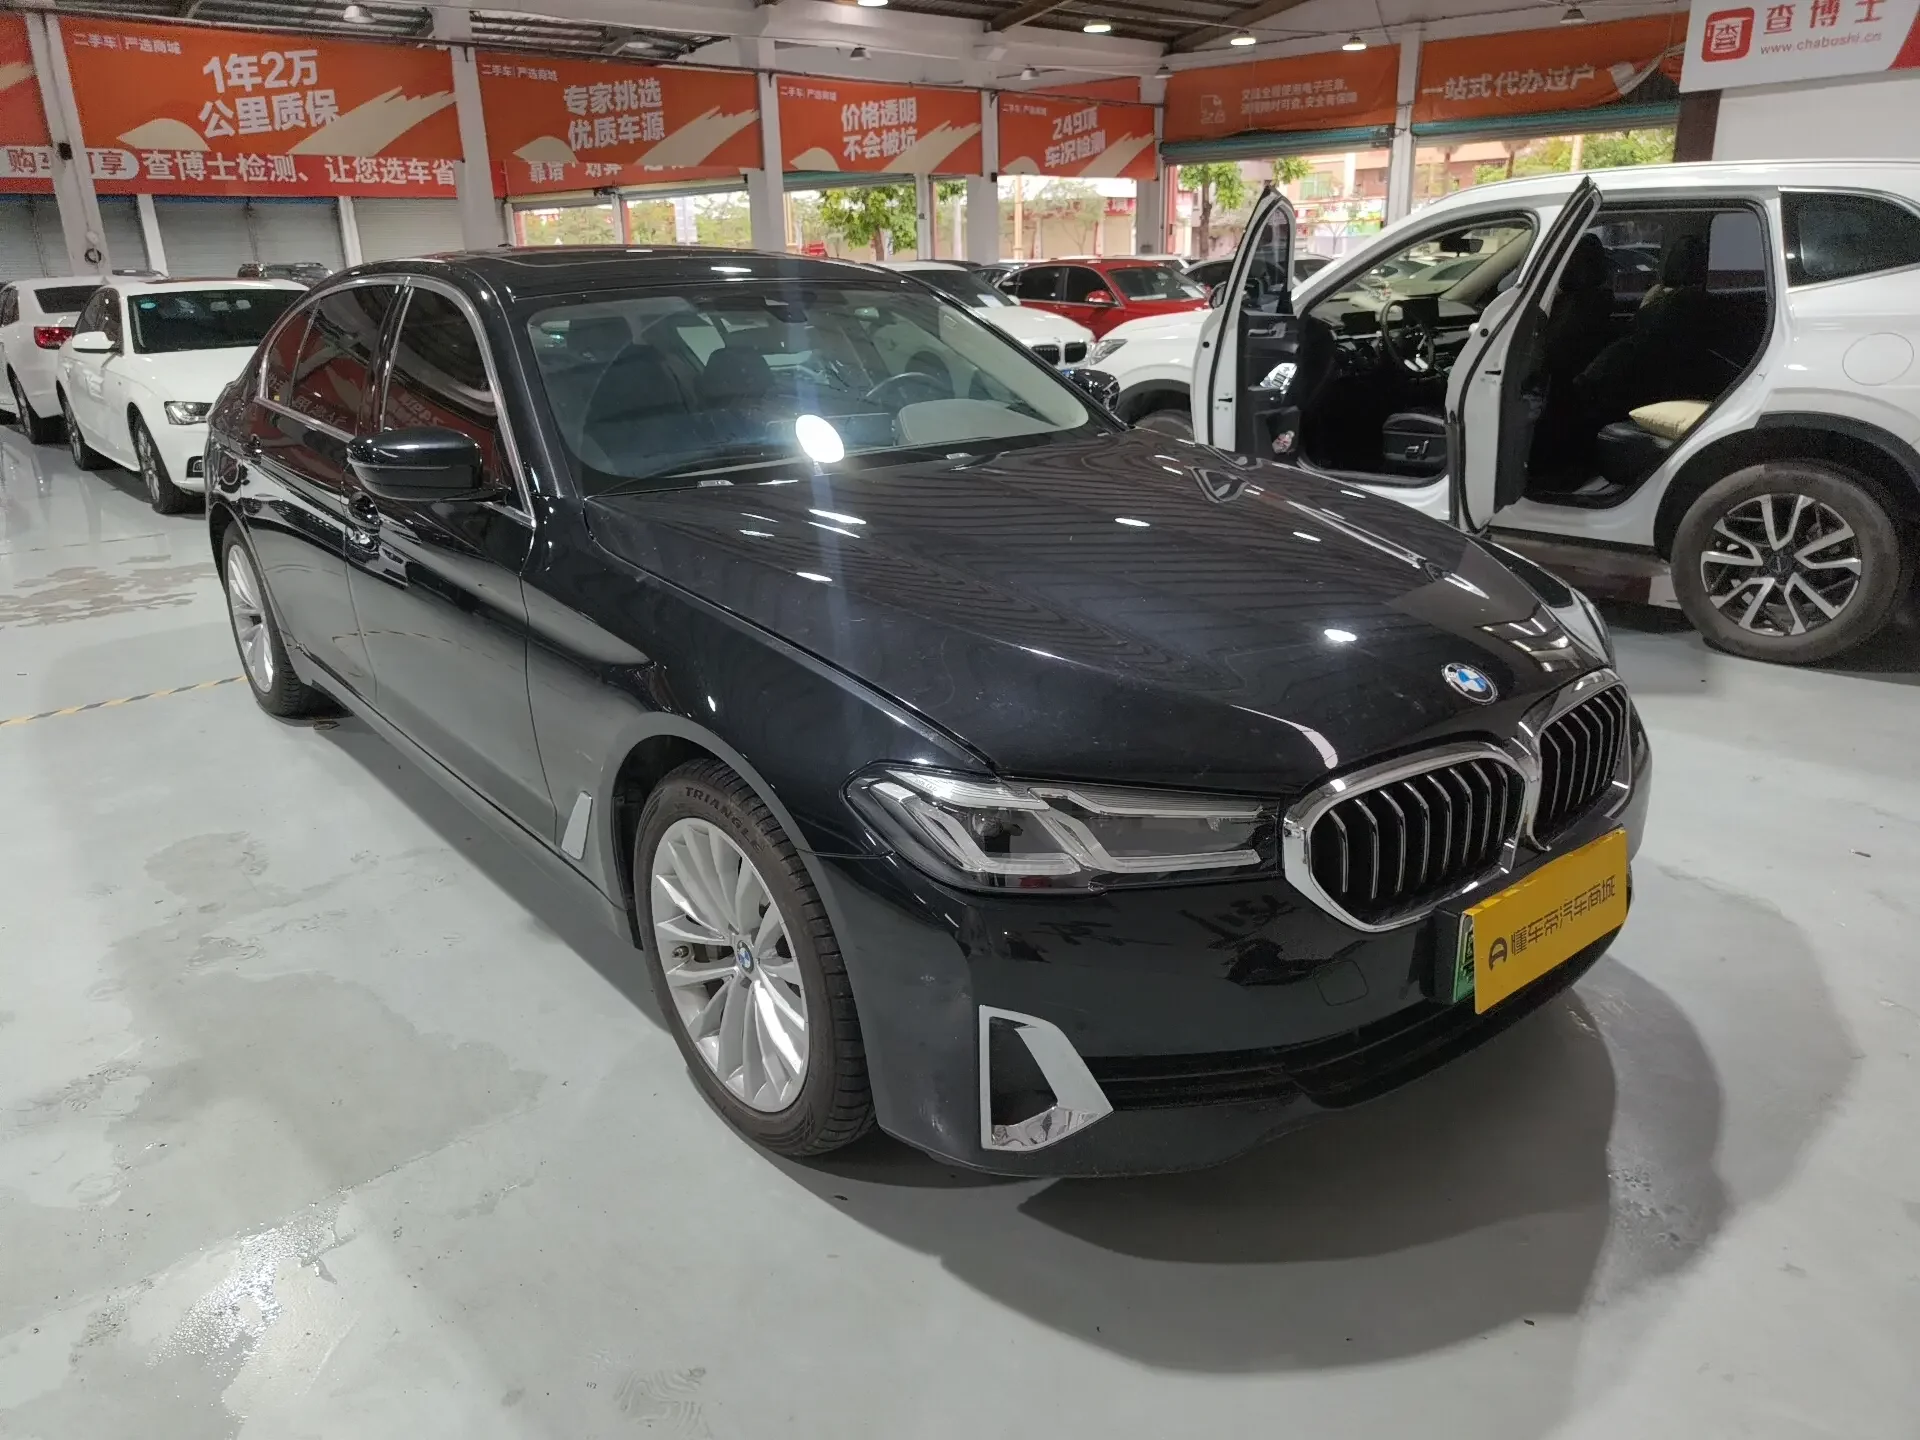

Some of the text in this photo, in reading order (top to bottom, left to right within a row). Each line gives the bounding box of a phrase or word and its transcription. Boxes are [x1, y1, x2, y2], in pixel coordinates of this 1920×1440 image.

[1763, 0, 1887, 34] 查博士
[1760, 32, 1882, 54] www.chaboshi.cn
[203, 49, 319, 93] 1年2万
[1422, 63, 1595, 100] 一站式代办过户
[198, 89, 340, 139] 公里质保
[563, 77, 663, 117] 专家挑选
[841, 96, 918, 133] 价格透明
[568, 111, 666, 151] 优质车源
[1052, 105, 1098, 141] 249项
[842, 126, 918, 162] 不会被坑
[685, 786, 764, 852] TRIANGLE
[1510, 874, 1616, 956] 懂车帝汽车商城
